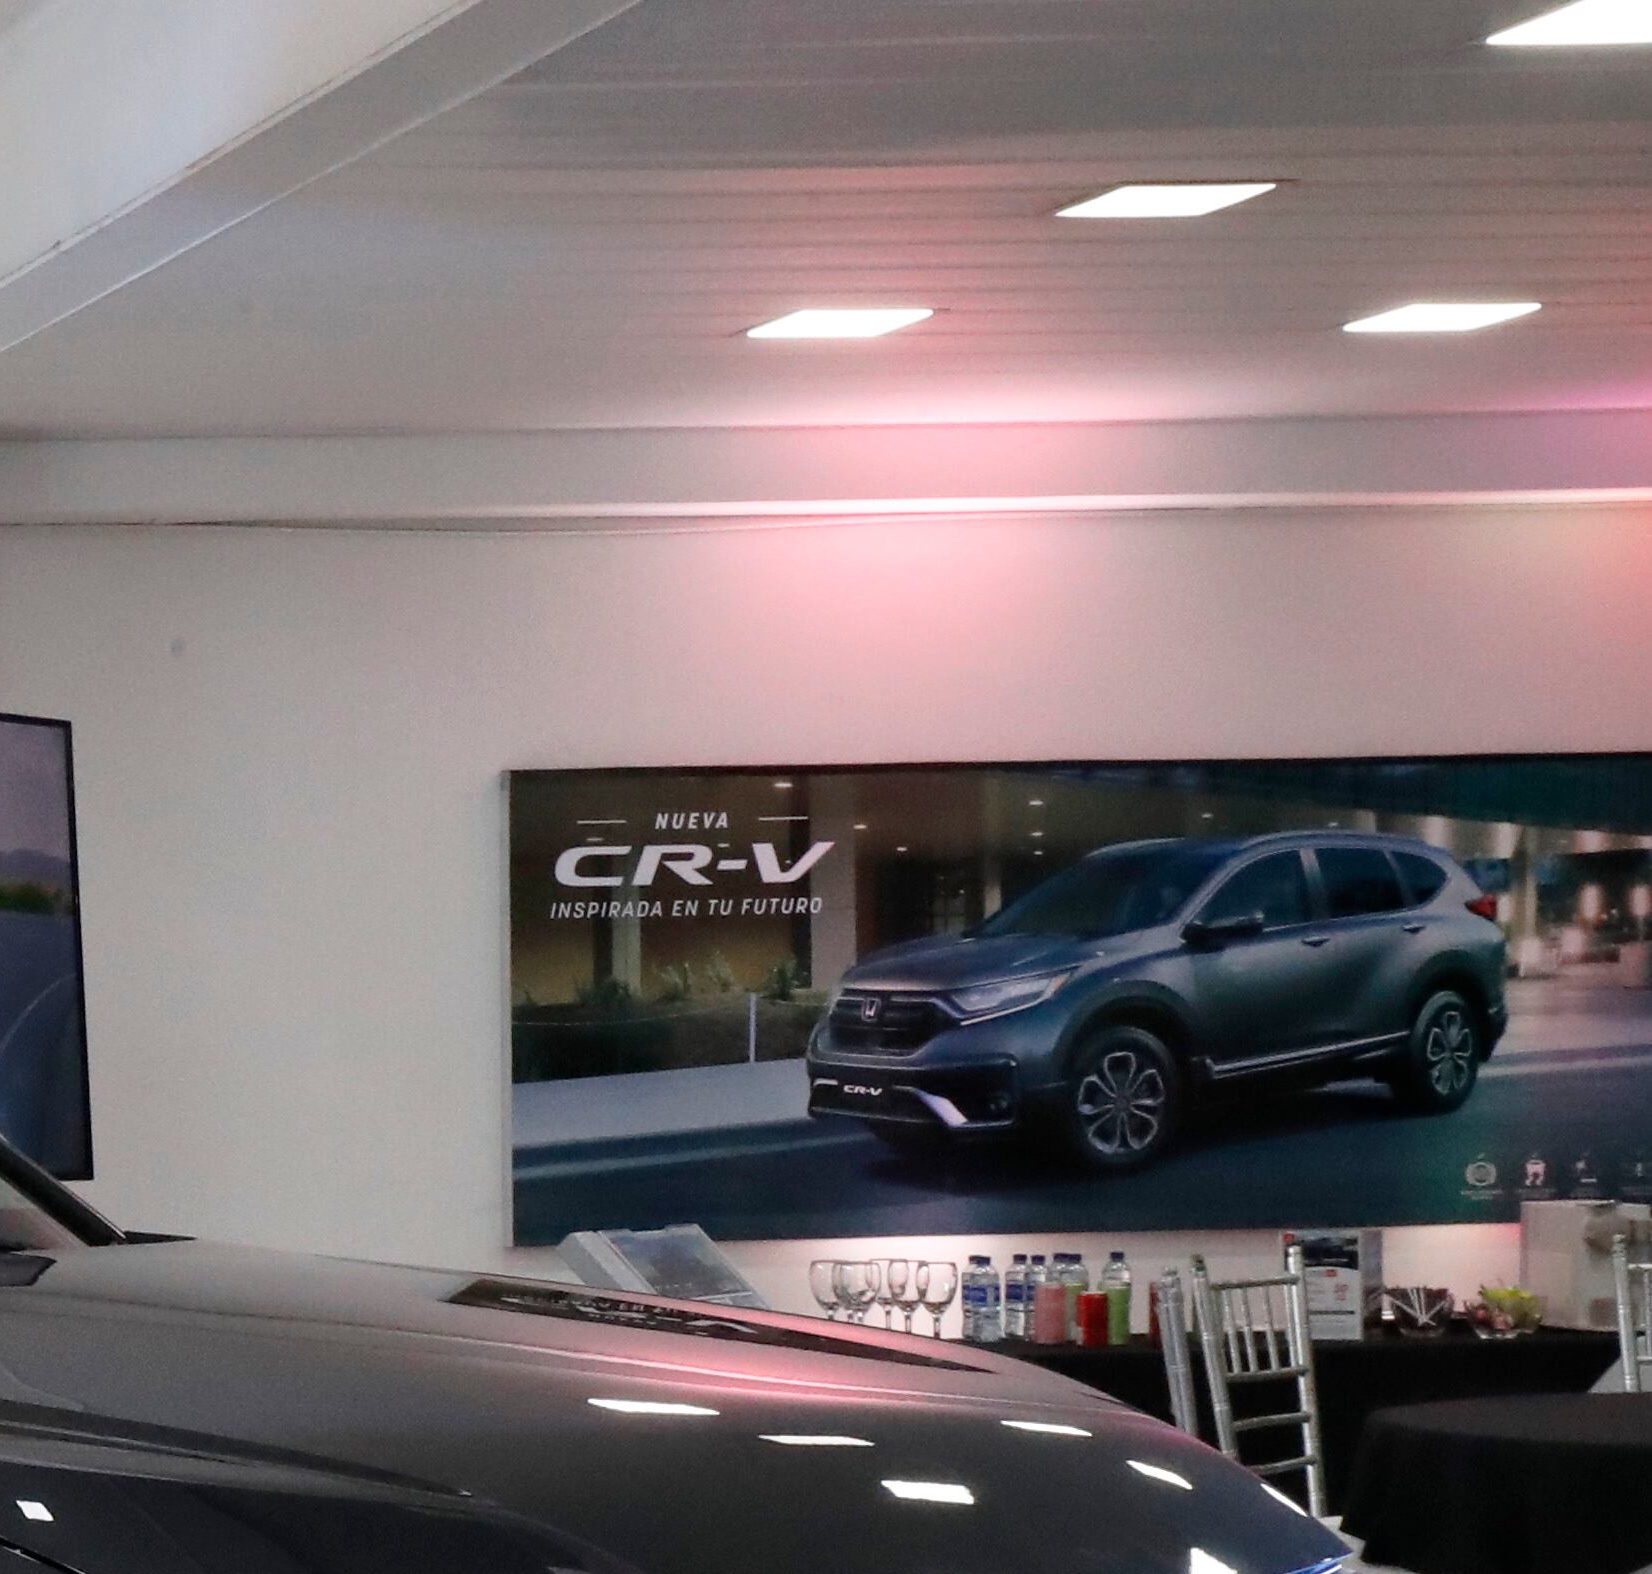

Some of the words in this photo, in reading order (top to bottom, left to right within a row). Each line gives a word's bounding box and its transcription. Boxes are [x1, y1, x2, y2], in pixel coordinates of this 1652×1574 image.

[655, 811, 729, 830] NUEVA
[554, 841, 835, 887] CR-V
[550, 901, 663, 920] INSPIRADA
[671, 900, 698, 916] EN
[708, 900, 732, 915] TU
[741, 897, 823, 915] FUTURO
[843, 1084, 883, 1096] CR-V
